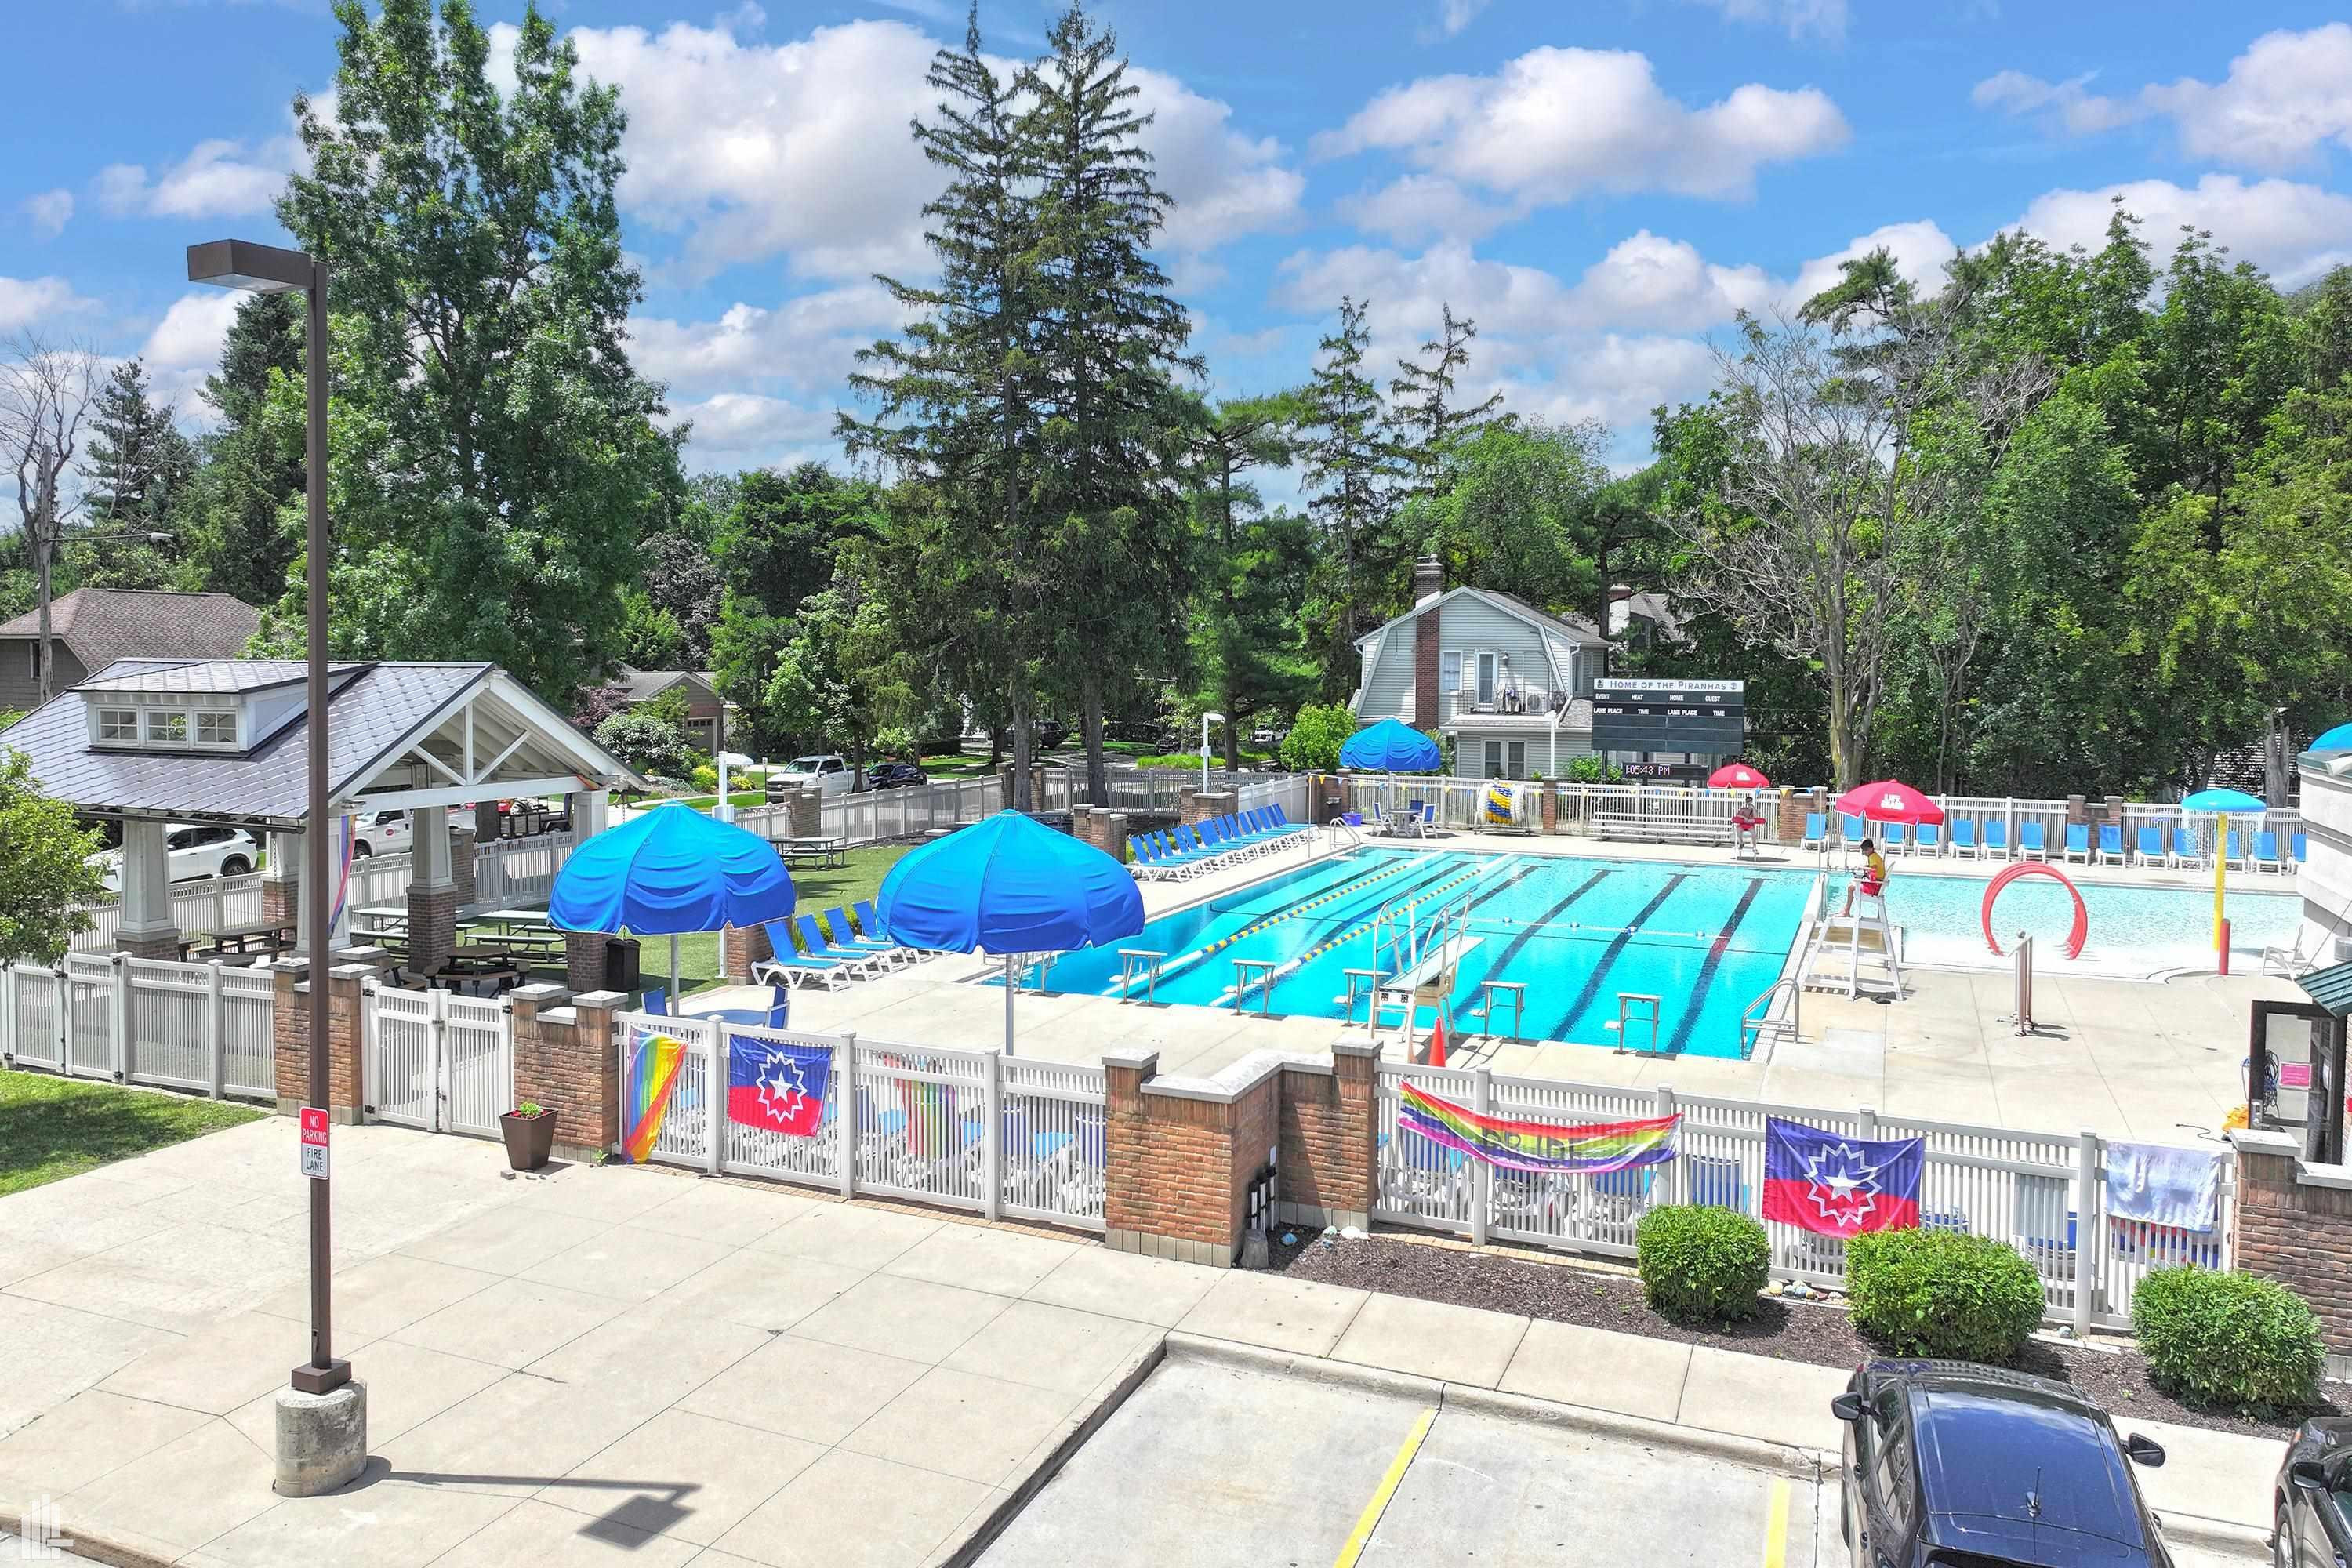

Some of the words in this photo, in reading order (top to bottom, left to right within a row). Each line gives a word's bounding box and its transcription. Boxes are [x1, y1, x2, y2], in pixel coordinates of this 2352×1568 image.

[1658, 765, 1670, 775] PM
[309, 1116, 319, 1128] NO
[302, 1128, 327, 1144] PARKING
[307, 1148, 322, 1160] FIRE
[306, 1160, 324, 1172] LANE
